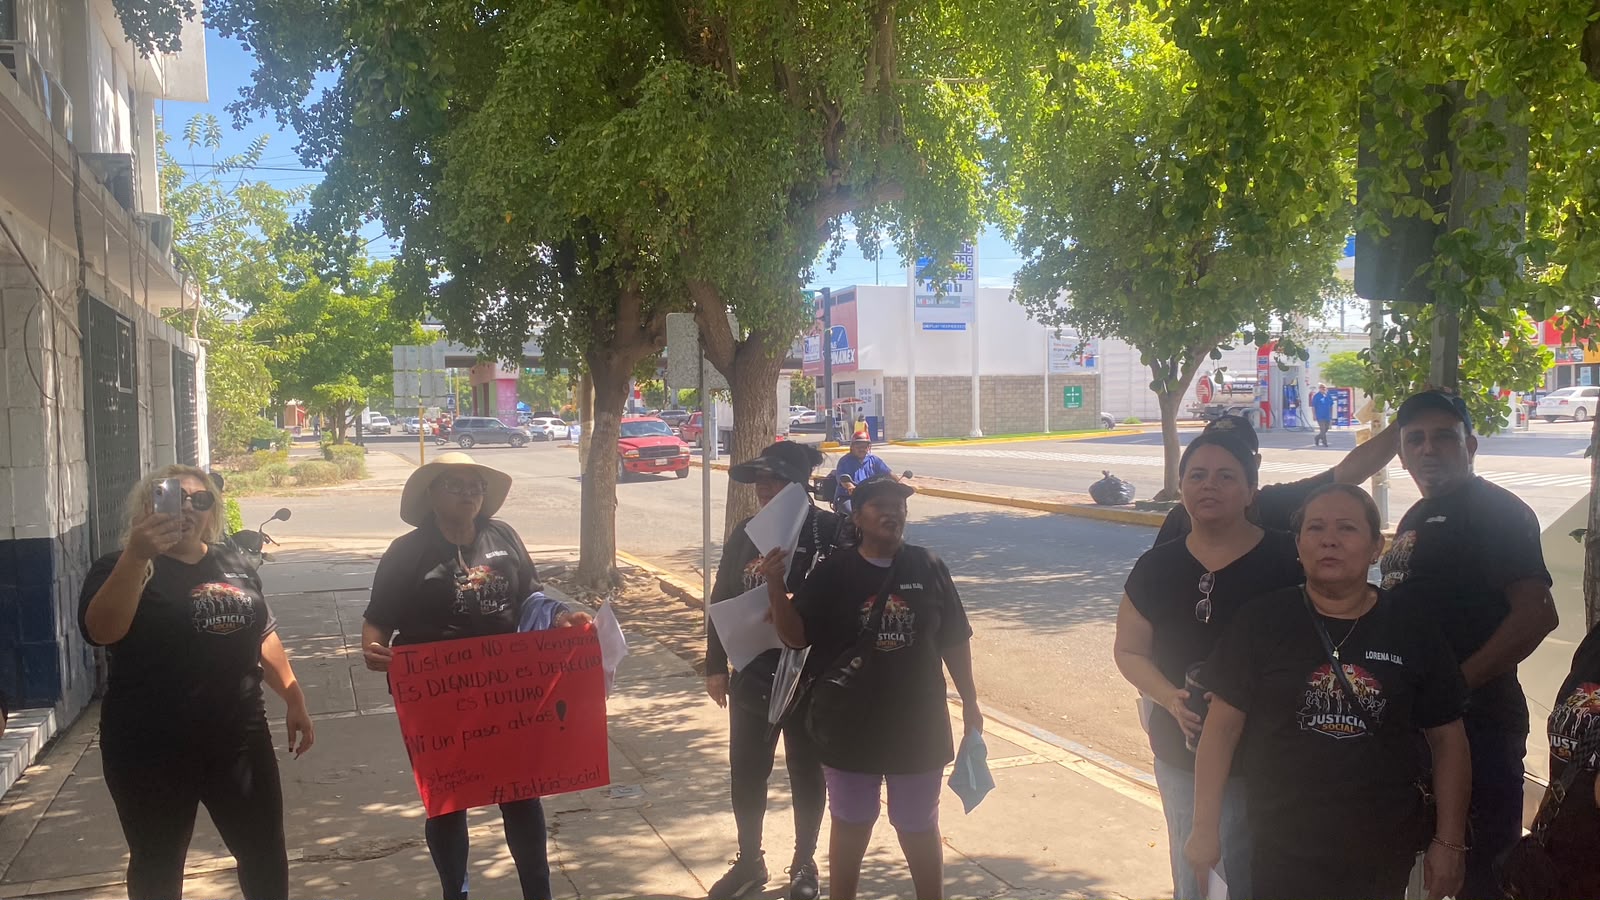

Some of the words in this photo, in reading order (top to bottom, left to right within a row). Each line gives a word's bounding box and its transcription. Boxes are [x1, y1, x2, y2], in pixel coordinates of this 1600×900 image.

[203, 615, 246, 628] JUSTICIA
[878, 633, 905, 642] STICIA
[397, 650, 473, 677] Justicia
[481, 639, 503, 658] NO
[510, 636, 528, 653] es
[1365, 650, 1390, 661] LORENA
[1390, 654, 1404, 664] LEAL
[427, 669, 508, 697] DIGNIDAD
[515, 665, 533, 679] es
[484, 686, 544, 707] FUTURO
[1308, 714, 1367, 729] JUSTICIA
[1322, 724, 1356, 733] SOCIAL
[462, 722, 501, 751] paso
